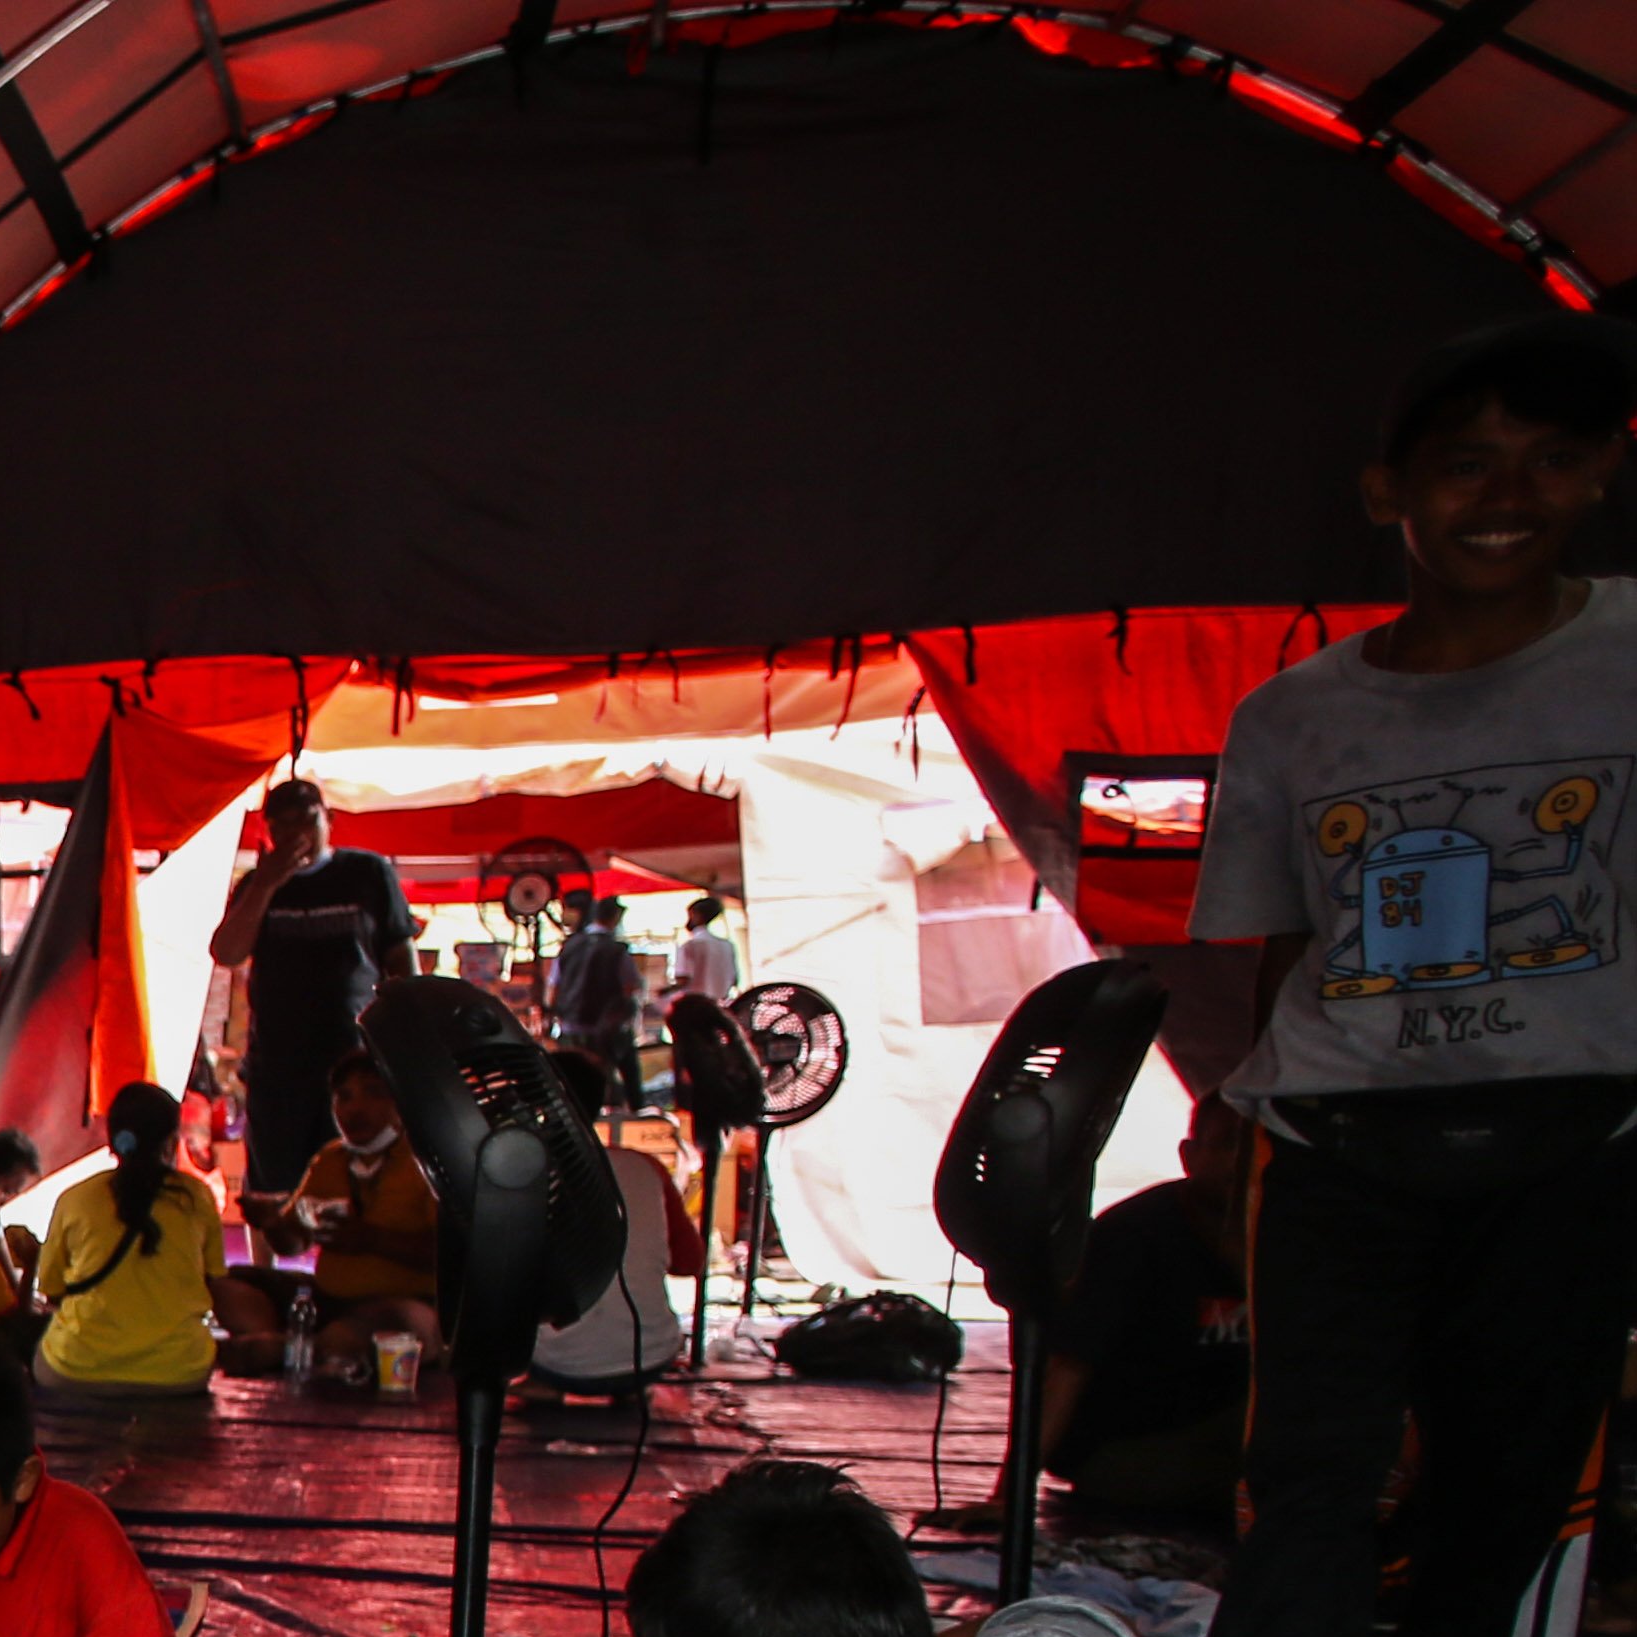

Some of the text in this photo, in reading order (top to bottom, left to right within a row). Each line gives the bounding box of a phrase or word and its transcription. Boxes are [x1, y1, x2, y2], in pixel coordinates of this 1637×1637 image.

[1378, 871, 1425, 900] DJ
[1378, 901, 1424, 929] 84
[1397, 1000, 1526, 1050] N.Y.C.
